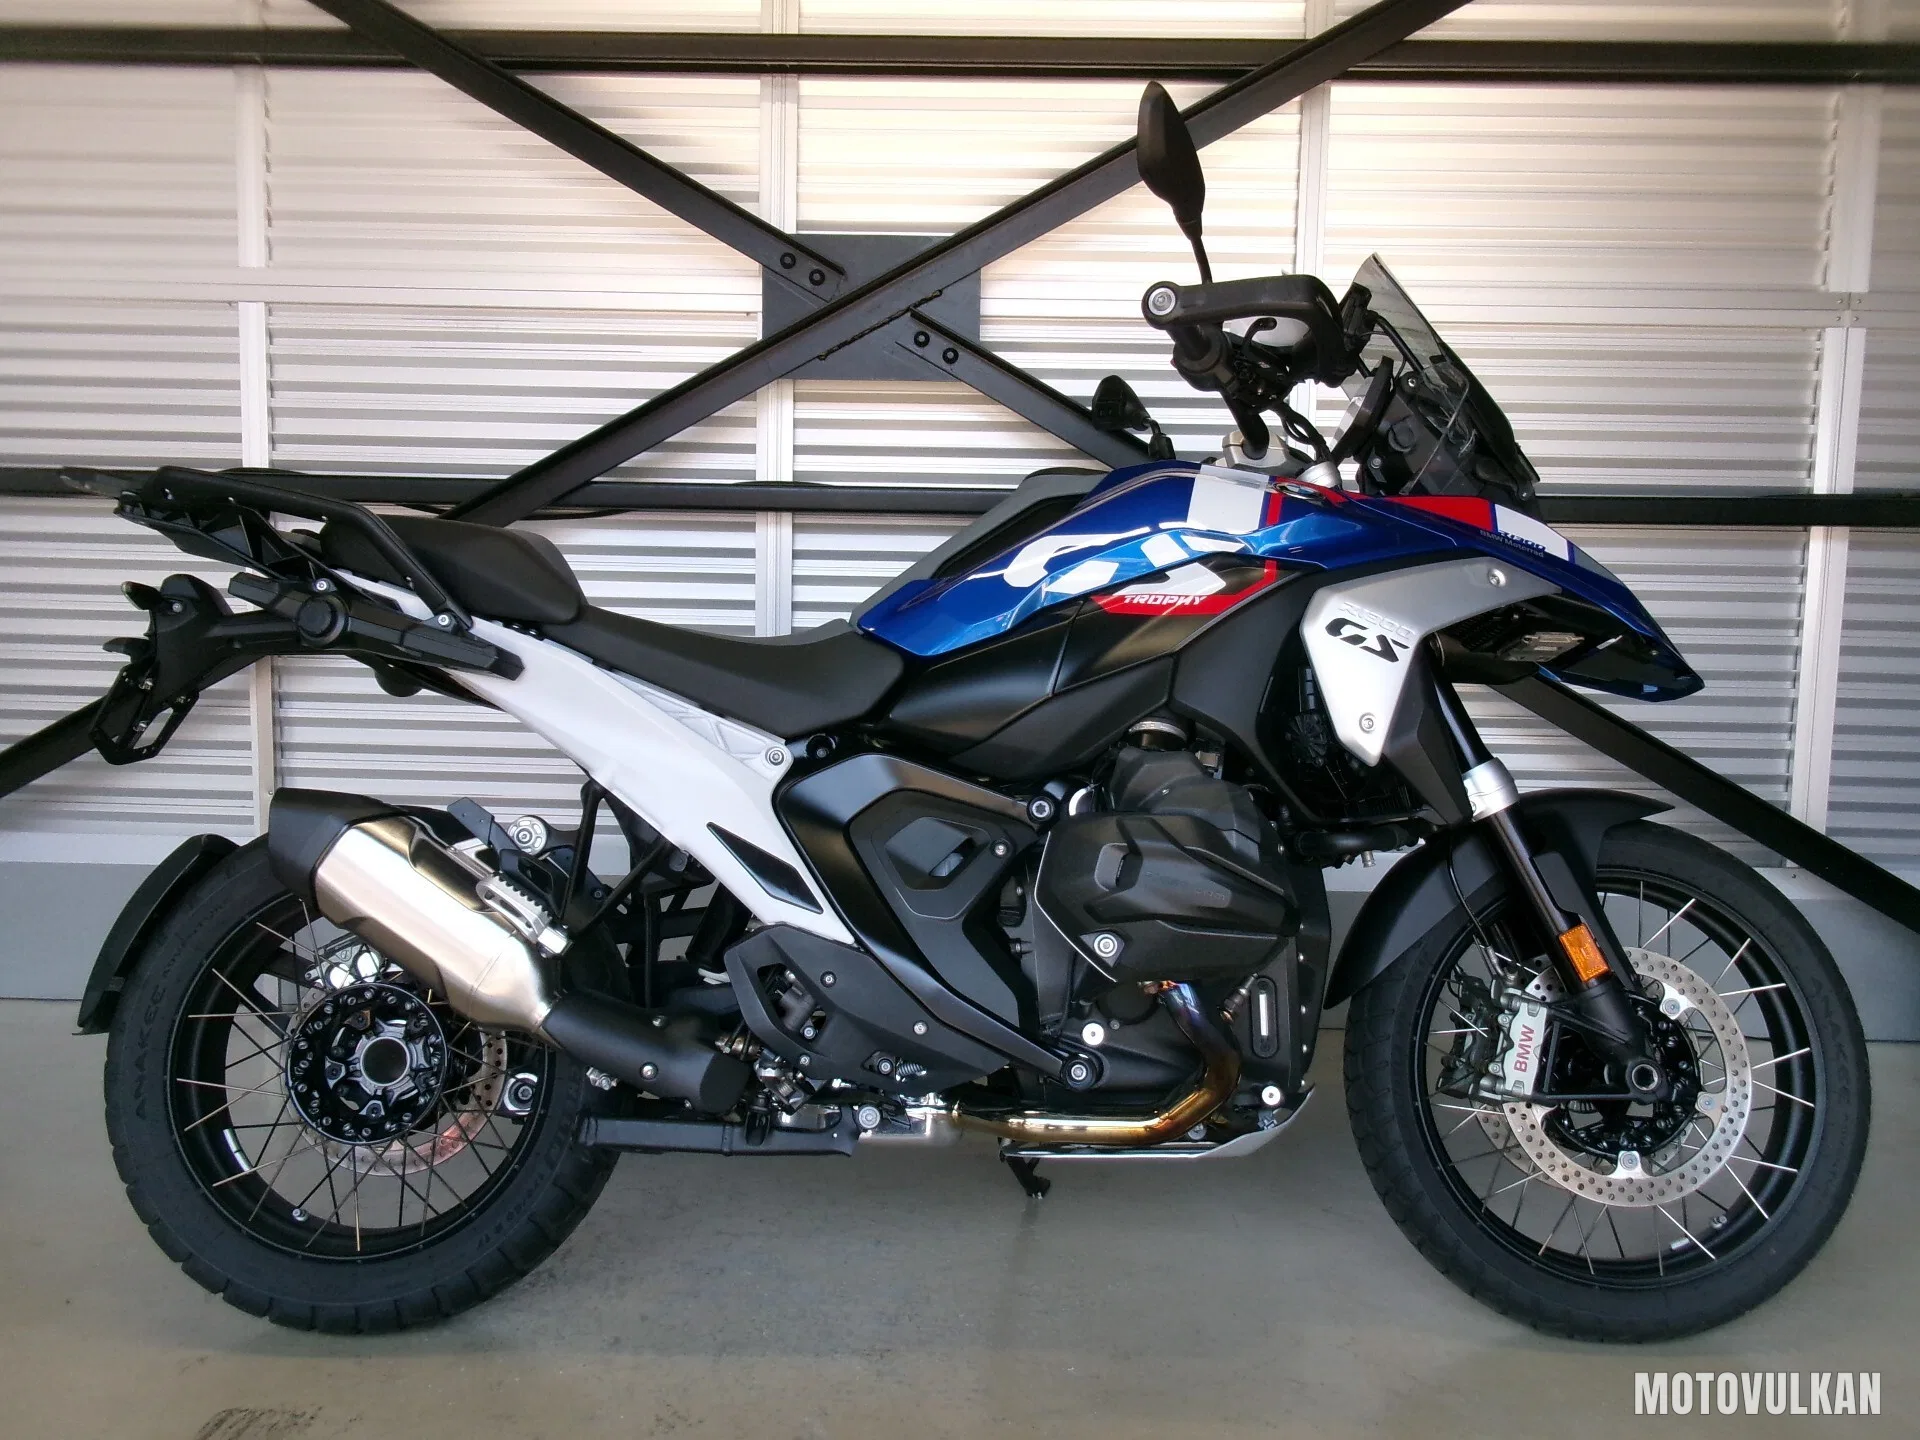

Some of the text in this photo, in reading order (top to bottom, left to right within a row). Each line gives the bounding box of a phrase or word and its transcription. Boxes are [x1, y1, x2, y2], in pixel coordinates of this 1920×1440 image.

[1504, 538, 1545, 558] Motorrad
[1123, 594, 1208, 606] TROPHY
[1325, 617, 1411, 663] GS
[1513, 1023, 1536, 1073] BMW
